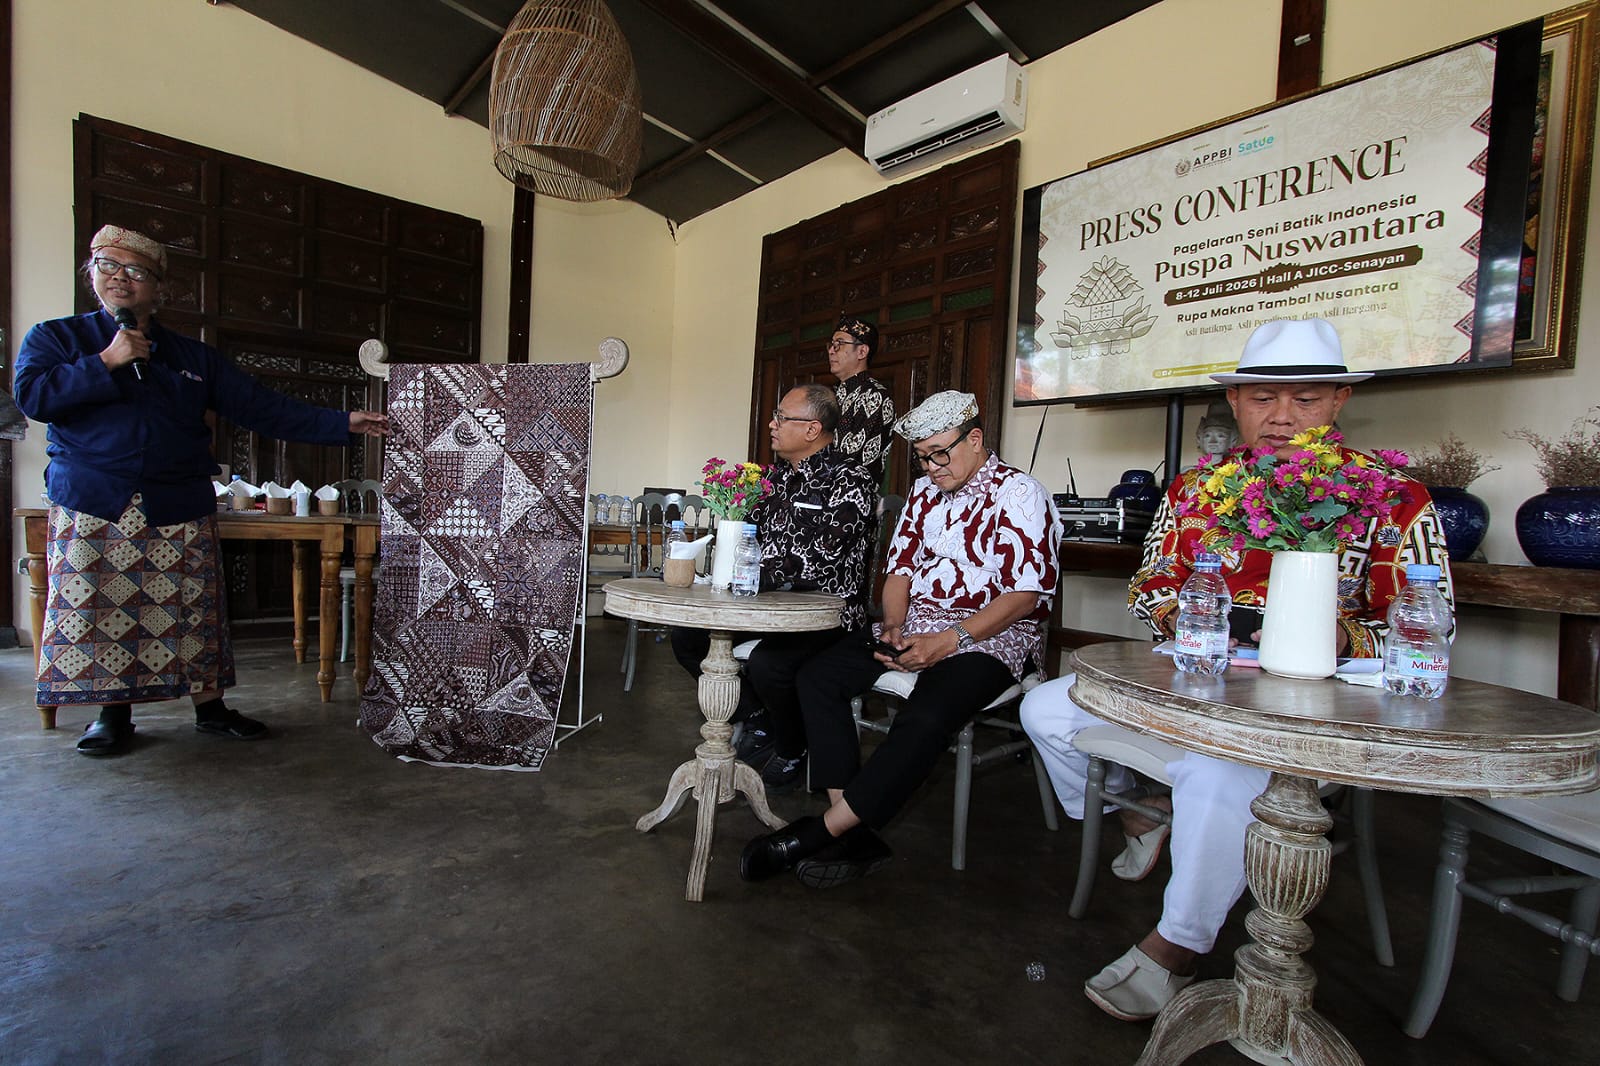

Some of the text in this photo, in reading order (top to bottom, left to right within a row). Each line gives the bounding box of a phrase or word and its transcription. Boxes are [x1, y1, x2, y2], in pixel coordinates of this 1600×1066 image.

[1193, 147, 1232, 166] APPBI
[1080, 136, 1407, 250] PRESS CONFERENCE
[1154, 209, 1445, 282] Puspa Nuswantara
[1173, 194, 1417, 255] Pagelaran Seni Batik Indonesia
[1175, 289, 1200, 300] 8-12
[1202, 284, 1223, 296] Juli
[1225, 279, 1257, 292] 2026
[1266, 272, 1291, 285] Hall
[1293, 270, 1303, 280] A
[1306, 253, 1405, 278] JICC-Senayan
[1177, 281, 1399, 323] Rupa Makna Tambal Nusantara
[1182, 631, 1192, 640] Le
[1433, 654, 1444, 664] Le
